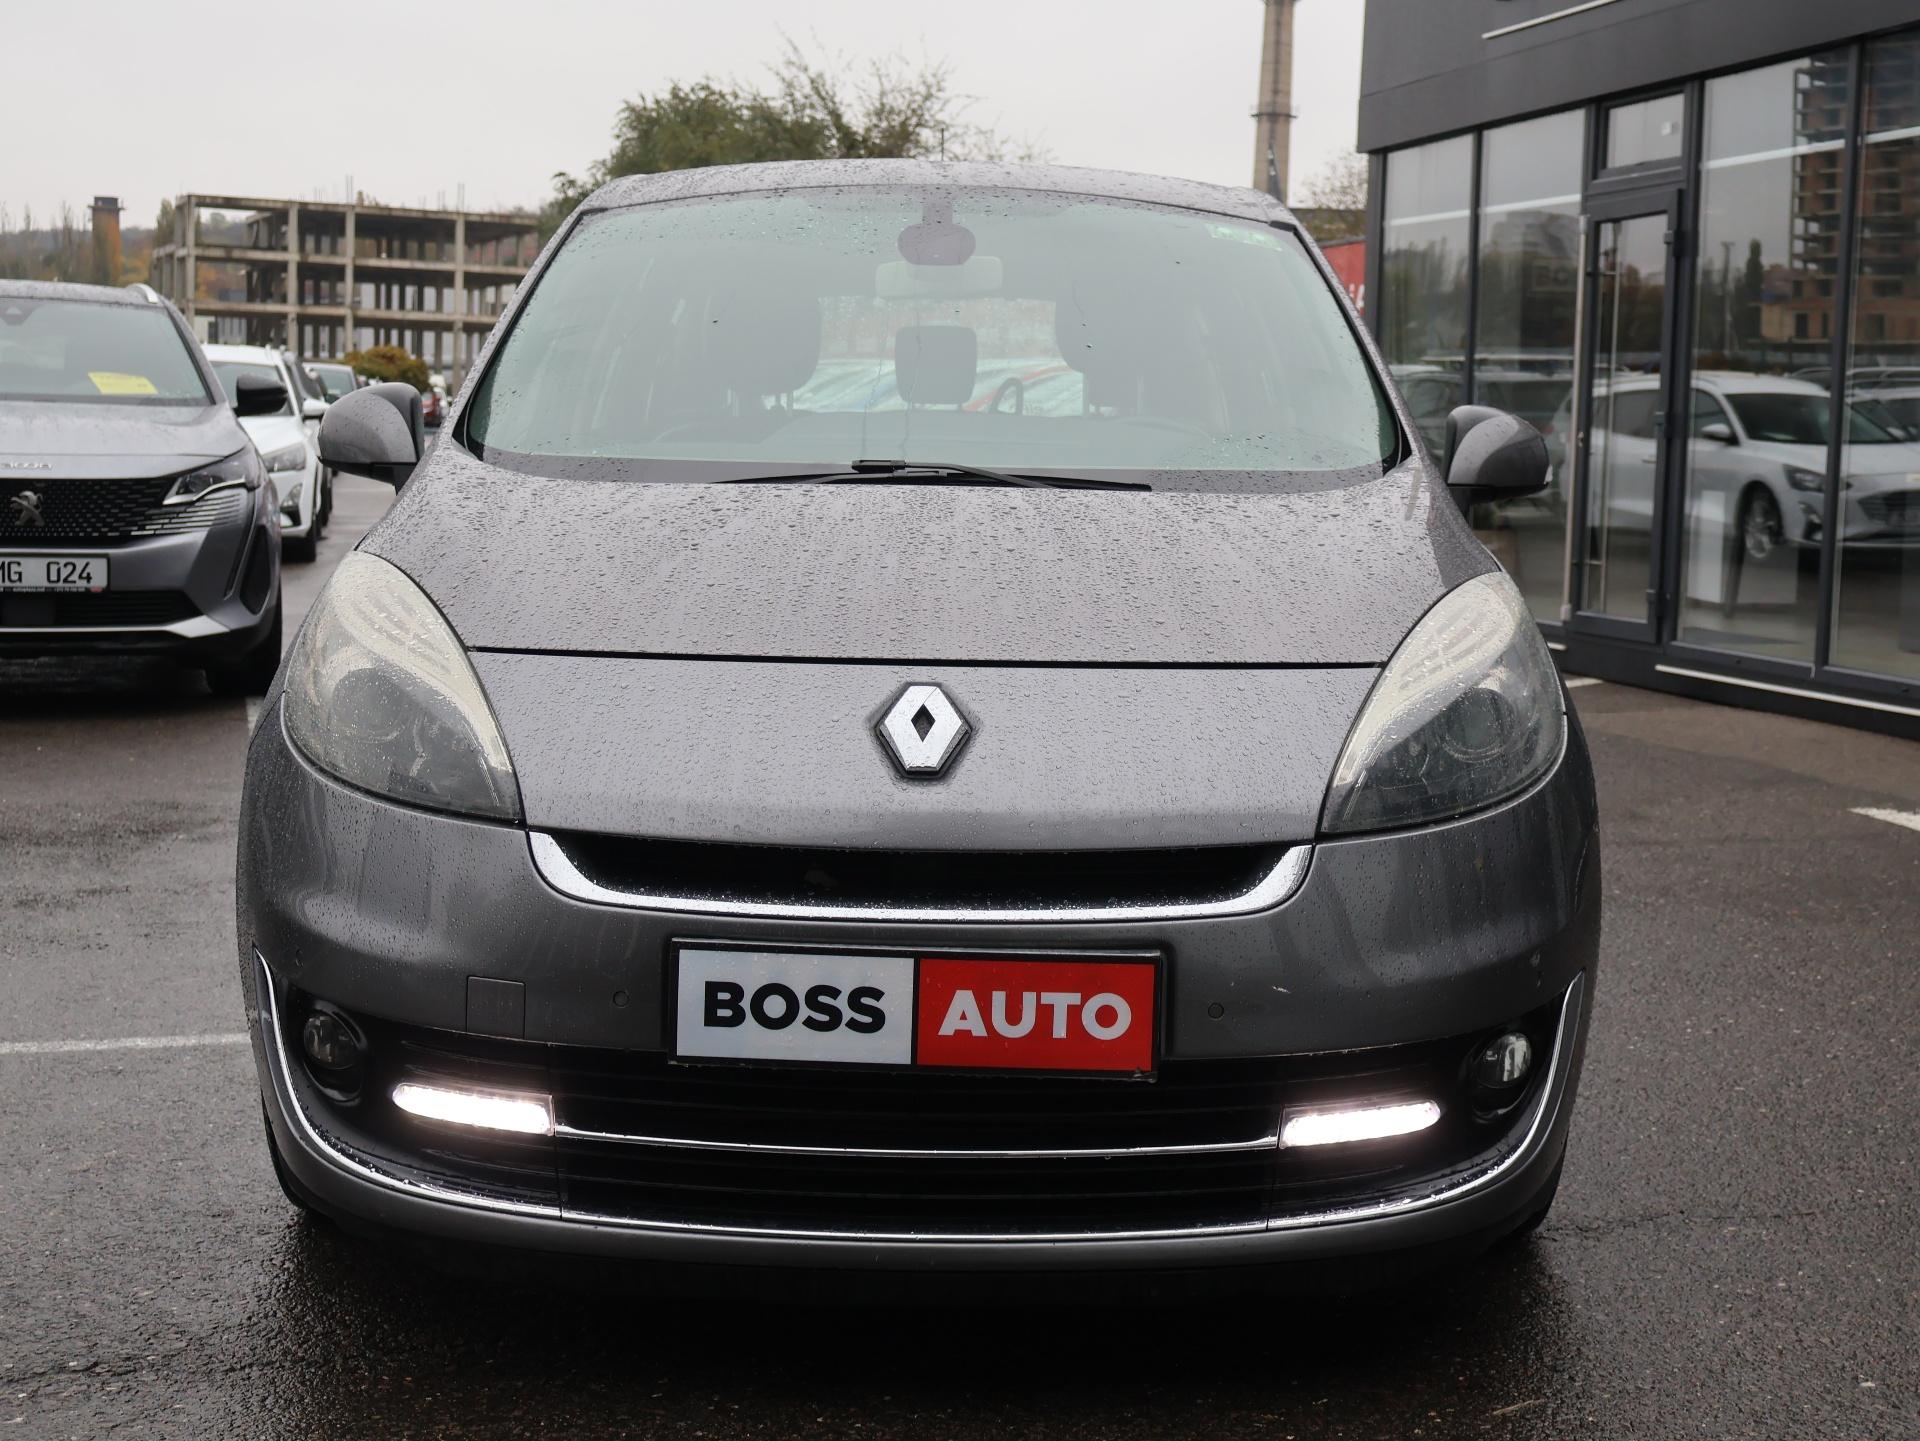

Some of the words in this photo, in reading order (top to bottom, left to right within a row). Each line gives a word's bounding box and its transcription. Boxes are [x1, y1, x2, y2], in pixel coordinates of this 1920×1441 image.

[46, 561, 92, 584] 024
[703, 980, 886, 1034] BOSS
[938, 989, 1132, 1041] AUTO
